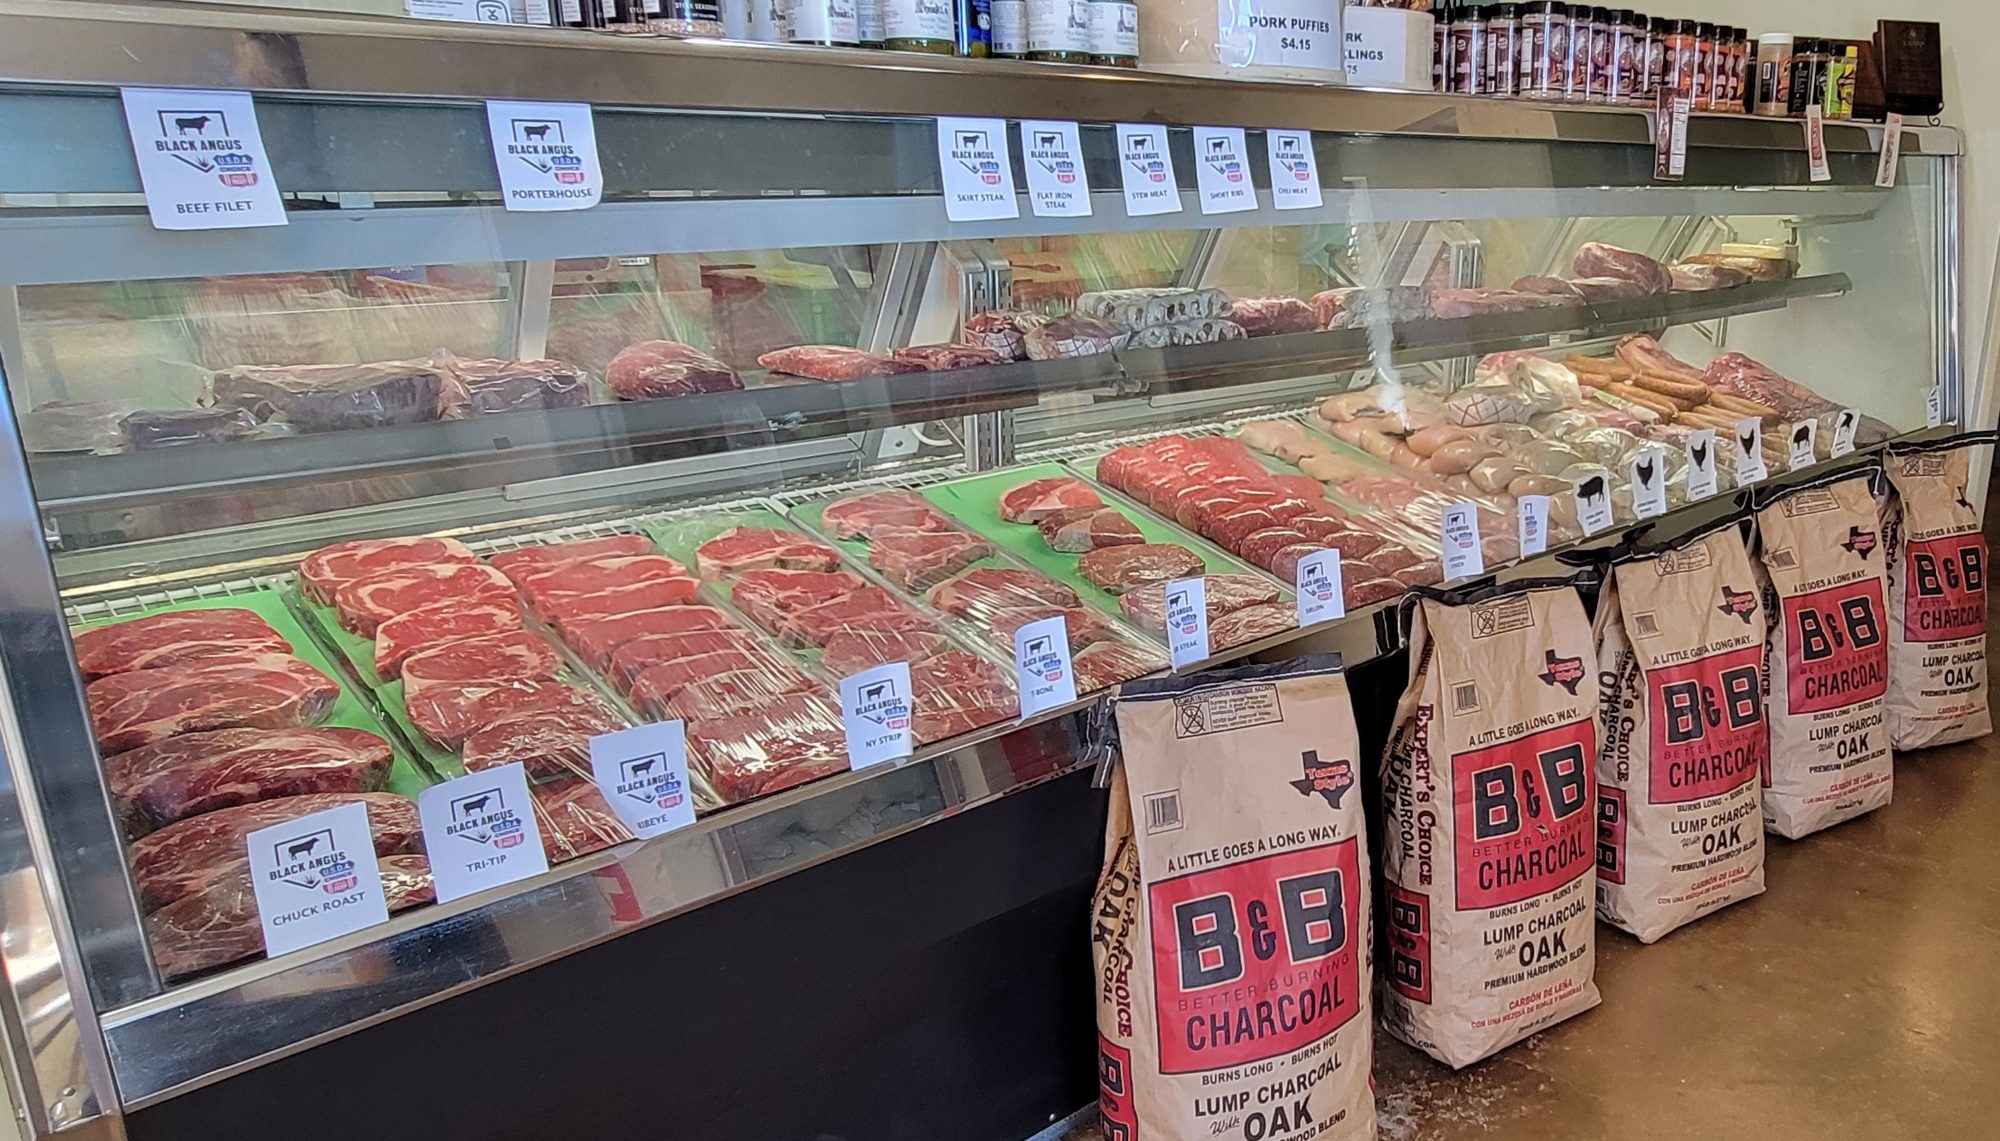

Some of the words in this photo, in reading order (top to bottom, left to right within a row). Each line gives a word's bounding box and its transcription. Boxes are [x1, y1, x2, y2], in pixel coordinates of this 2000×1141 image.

[1250, 15, 1287, 30] PORK
[1291, 18, 1330, 33] PUFFIES
[1280, 37, 1311, 51] $4.15
[155, 139, 196, 151] BLACK
[200, 139, 242, 151] ANGUS
[508, 144, 539, 154] BLACK
[542, 145, 574, 155] ANGUS
[952, 150, 972, 159] BLACK
[973, 151, 995, 160] ANGUS
[1031, 150, 1049, 159] BLACK
[1050, 151, 1070, 160] ANGUS
[1125, 153, 1141, 161] BLACK
[1142, 152, 1160, 160] ANGUS
[1205, 154, 1219, 163] BLACK
[1221, 153, 1236, 162] ANGUS
[512, 188, 593, 199] PORTERHOUSE
[957, 193, 979, 202] SKIRT
[981, 193, 1005, 202] STEAK
[1037, 191, 1053, 200] FLAT
[1055, 191, 1072, 200] IRON
[1132, 191, 1149, 200] STEW
[1151, 190, 1168, 198] MEAT
[1210, 191, 1228, 200] SHORT
[1230, 190, 1244, 199] RIBS
[1293, 187, 1309, 195] MEAT
[176, 202, 210, 214] BEEF
[216, 200, 253, 212] FILET
[1045, 201, 1066, 209] STEAK
[1793, 584, 1799, 593] A
[1827, 578, 1832, 586] A
[1180, 640, 1198, 651] STEAK
[1653, 655, 1660, 666] A
[1661, 649, 1690, 664] LITTLE
[1711, 639, 1734, 651] LONG
[1922, 656, 1950, 668] LUMP
[1805, 661, 1884, 700] CHARCOAL
[1944, 666, 1974, 686] OAK
[855, 702, 877, 716] BLACK
[878, 697, 903, 709] ANGUS
[1468, 735, 1476, 747] A
[1477, 728, 1506, 743] LITTLE
[1530, 714, 1556, 731] LONG
[1602, 684, 1623, 763] CHARCOAL
[1809, 726, 1840, 741] LUMP
[865, 738, 878, 748] NY
[878, 733, 903, 745] STRIP
[1616, 715, 1635, 783] CHOICE
[1836, 732, 1870, 760] OAK
[1414, 703, 1436, 804] EXPERT'S
[1306, 764, 1349, 780] Texas
[1669, 744, 1758, 788] CHARCOAL
[616, 780, 645, 795] BLACK
[646, 772, 676, 787] ANGUS
[1313, 776, 1350, 791] Style
[1671, 818, 1708, 835] LUMP
[1711, 797, 1757, 829] CHARCOAL
[1677, 801, 1702, 813] BURNS
[446, 818, 479, 836] BLACK
[481, 809, 514, 826] ANGUS
[1399, 774, 1415, 864] CHARCOAL
[1472, 837, 1532, 858] BETTER
[1541, 812, 1590, 843] BURNING
[1702, 823, 1742, 856] OAK
[1167, 858, 1176, 873] A
[1176, 849, 1220, 870] LITTLE
[1222, 841, 1255, 860] GOES
[1257, 839, 1266, 851] A
[1269, 830, 1306, 850] LONG
[1308, 823, 1341, 842] WAY.
[1417, 810, 1438, 887] CHOICE
[269, 862, 306, 881] BLACK
[308, 851, 347, 870] ANGUS
[465, 854, 507, 872] TRI-TIP
[1478, 831, 1586, 890] CHARCOAL
[1671, 860, 1706, 873] PREMIUM
[272, 905, 319, 926] CHUCK
[323, 891, 366, 913] ROAST
[1489, 905, 1518, 919] BURNS
[1520, 899, 1541, 913] LONG
[1483, 923, 1524, 946] LUMP
[1528, 896, 1587, 935] CHARCOAL
[1519, 927, 1568, 967] OAK
[1484, 972, 1525, 990] PREMIUM
[1526, 956, 1568, 980] HARDWOOD
[1569, 943, 1587, 962] BLEND
[1178, 985, 1258, 1012] BETTER
[1269, 954, 1350, 992] BURNING
[1543, 987, 1553, 999] DE
[1186, 976, 1345, 1051] CHARCOAL
[1202, 1070, 1241, 1086] BURNS
[1244, 1061, 1274, 1078] LONG
[1291, 1045, 1321, 1065] BURNS
[1323, 1033, 1339, 1050] HOT
[1195, 1091, 1250, 1117] LUMP
[1257, 1052, 1342, 1104] CHARCOAL
[1243, 1092, 1313, 1141] OAK
[1318, 1109, 1346, 1133] BLEND
